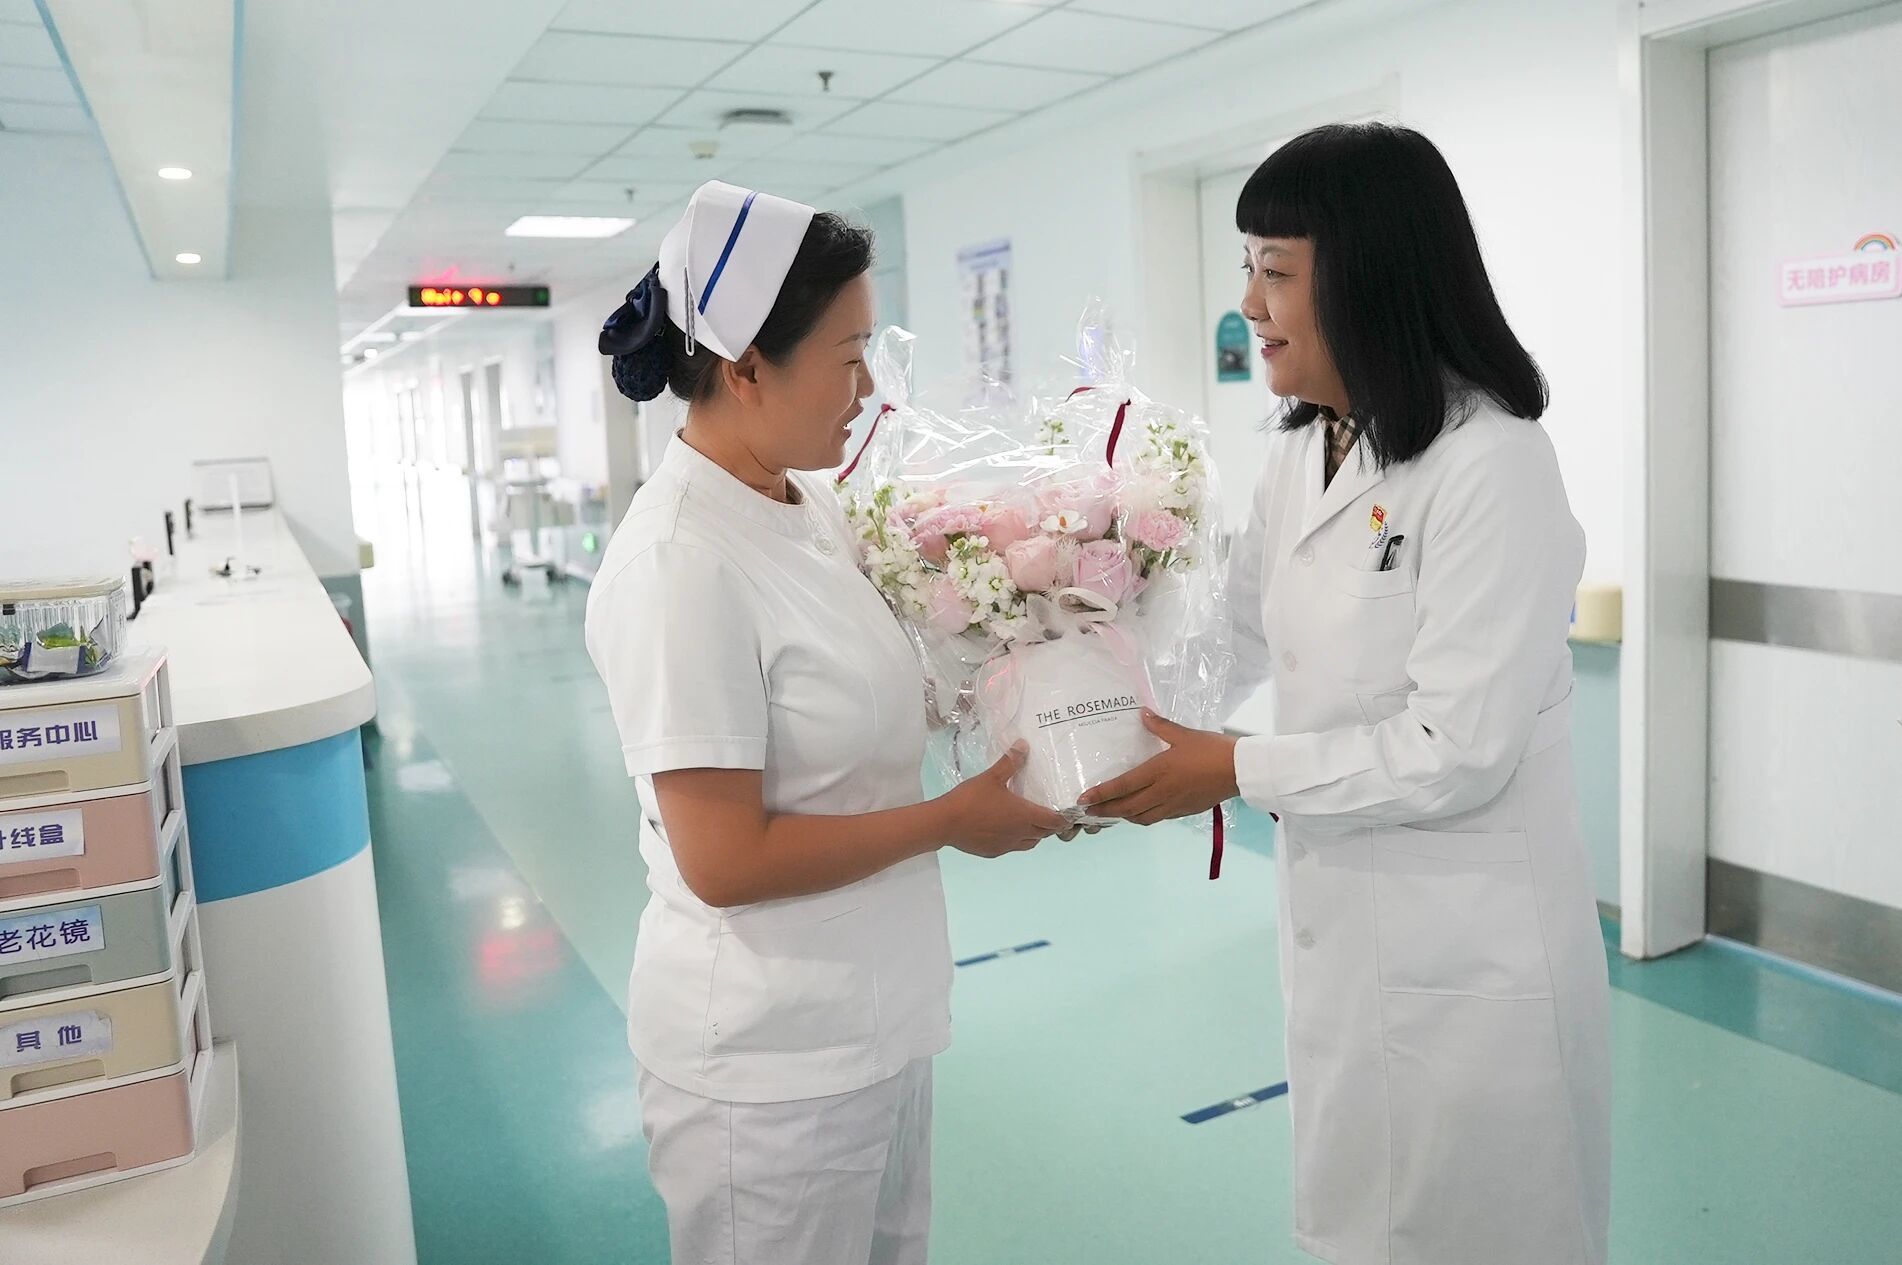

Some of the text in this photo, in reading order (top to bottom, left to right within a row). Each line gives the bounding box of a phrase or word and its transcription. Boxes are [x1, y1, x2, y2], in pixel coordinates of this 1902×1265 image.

[1786, 261, 1890, 291] 无陪护病房
[1035, 695, 1137, 724] THE ROSEMADA
[0, 823, 64, 850] 线盒
[0, 918, 91, 954] 老花镜
